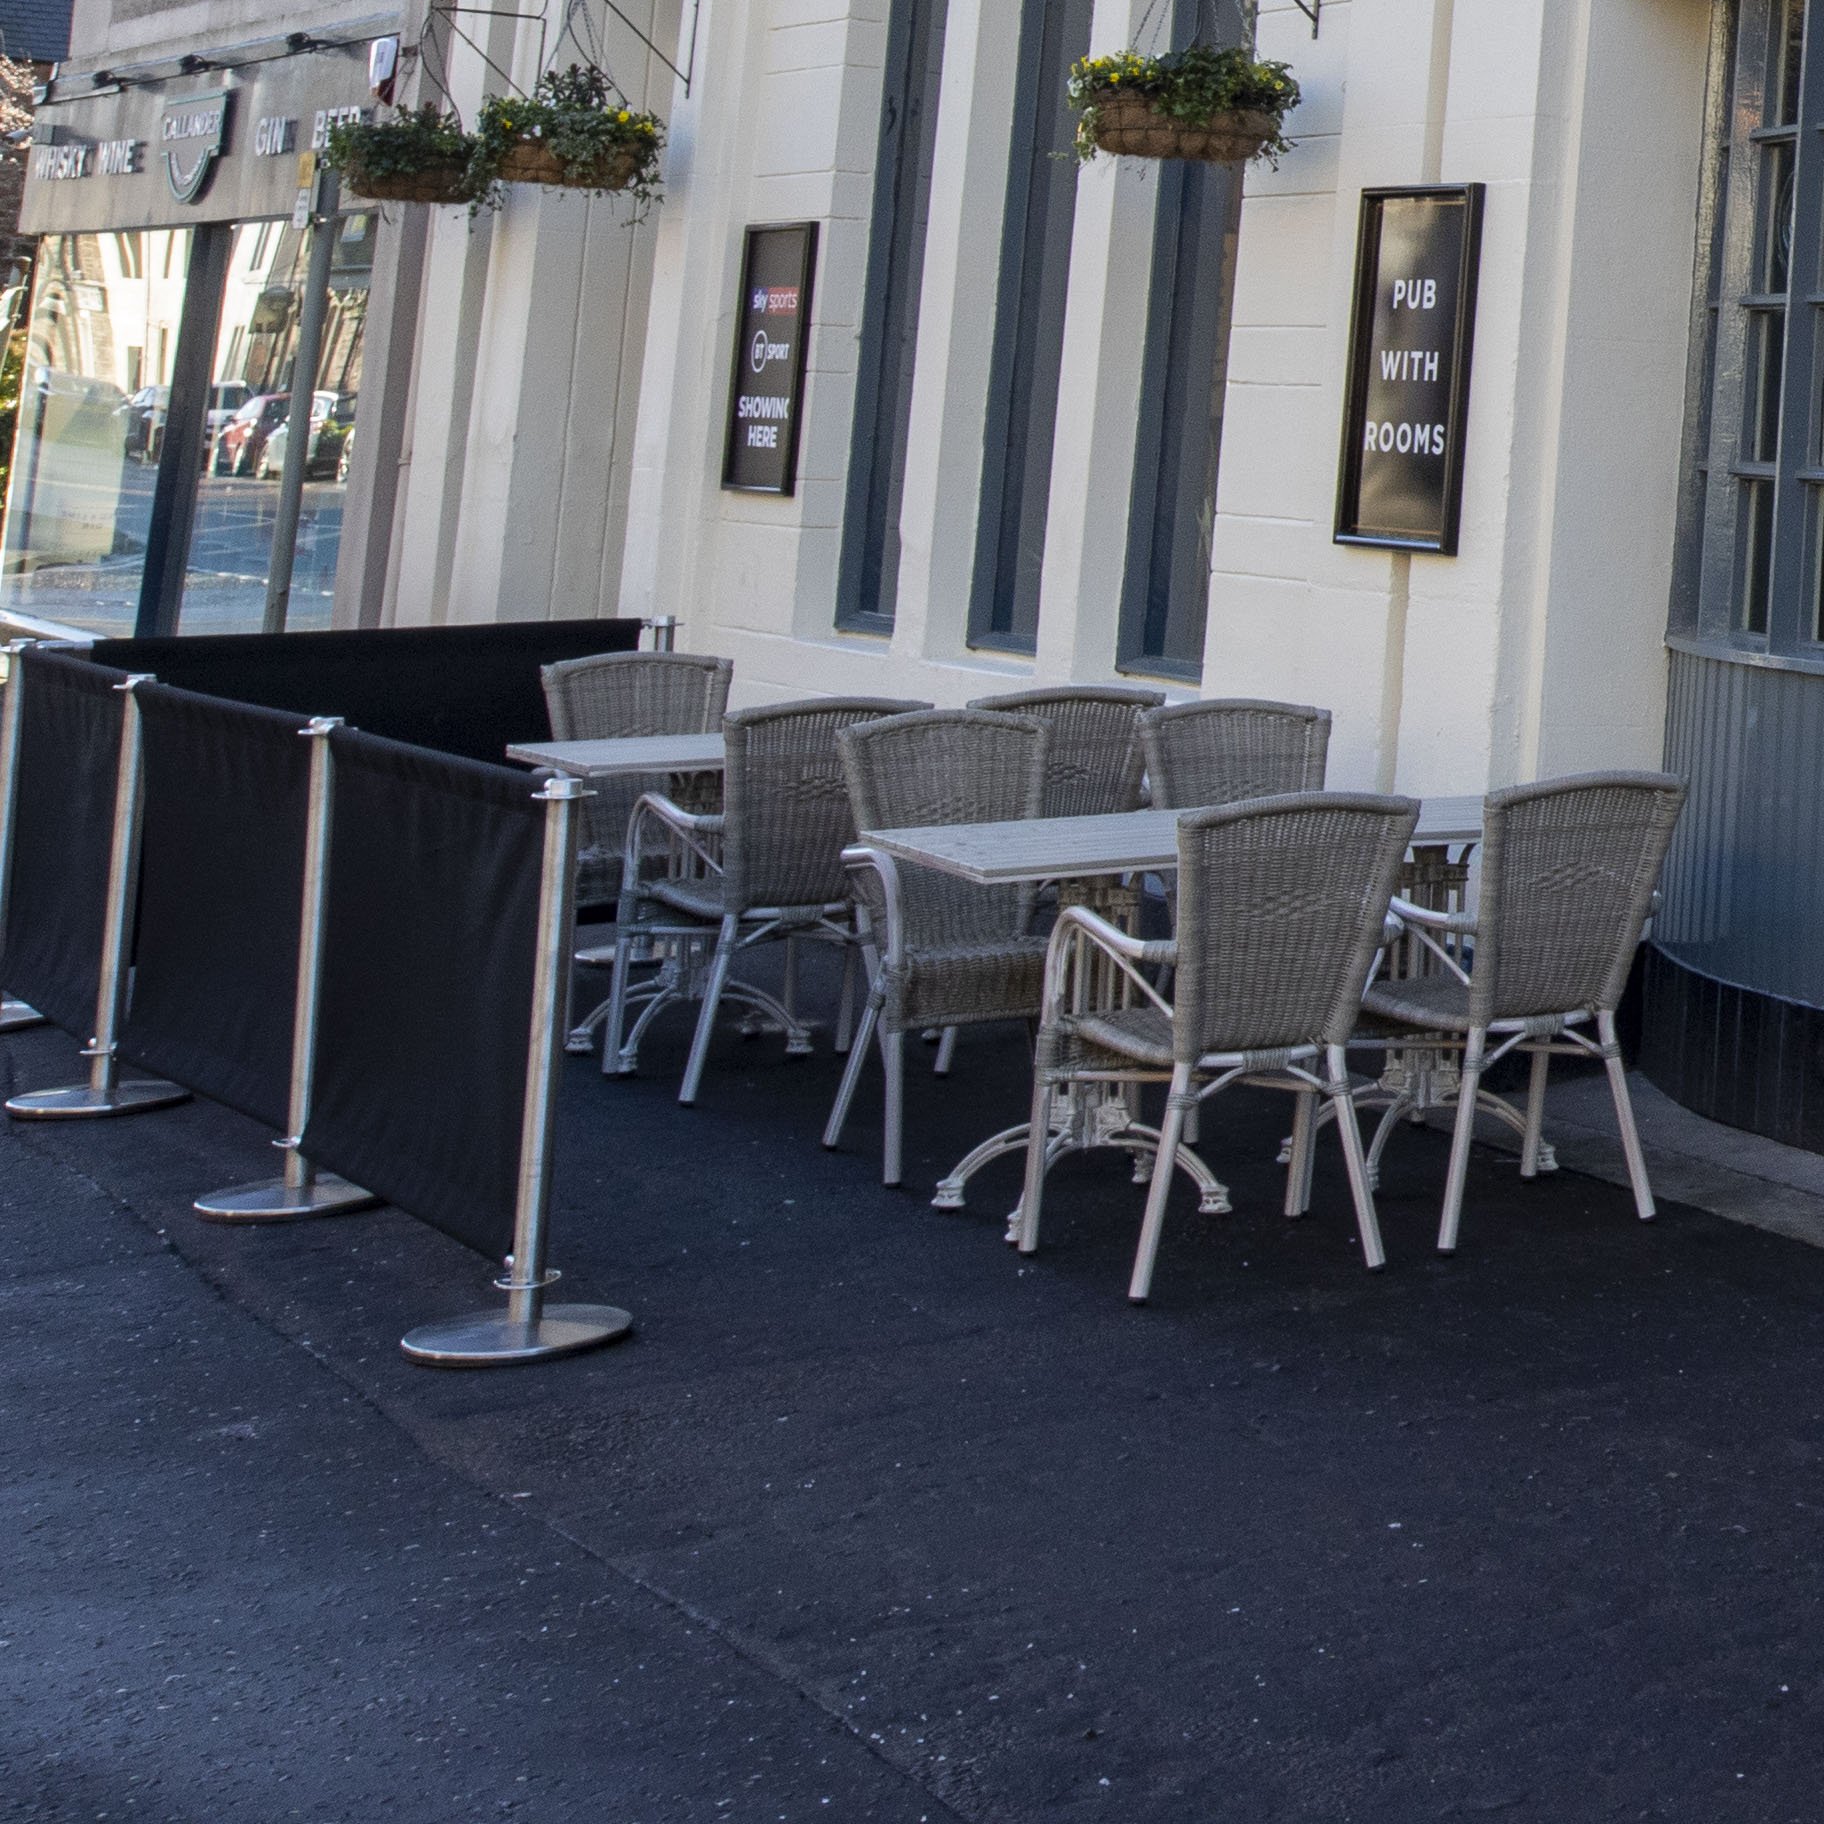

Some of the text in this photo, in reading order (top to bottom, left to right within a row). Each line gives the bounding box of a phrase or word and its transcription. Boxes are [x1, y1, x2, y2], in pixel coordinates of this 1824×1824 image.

[163, 111, 220, 141] CALLANDER
[255, 116, 287, 156] GIN
[34, 145, 87, 179] WHISKY
[98, 139, 135, 176] WINE
[753, 288, 798, 313] sky sports
[1393, 279, 1436, 309] PUB
[755, 344, 790, 360] BT SPORT
[1381, 350, 1439, 382] WITH
[747, 425, 778, 448] HERE
[1364, 421, 1445, 455] ROOMS
